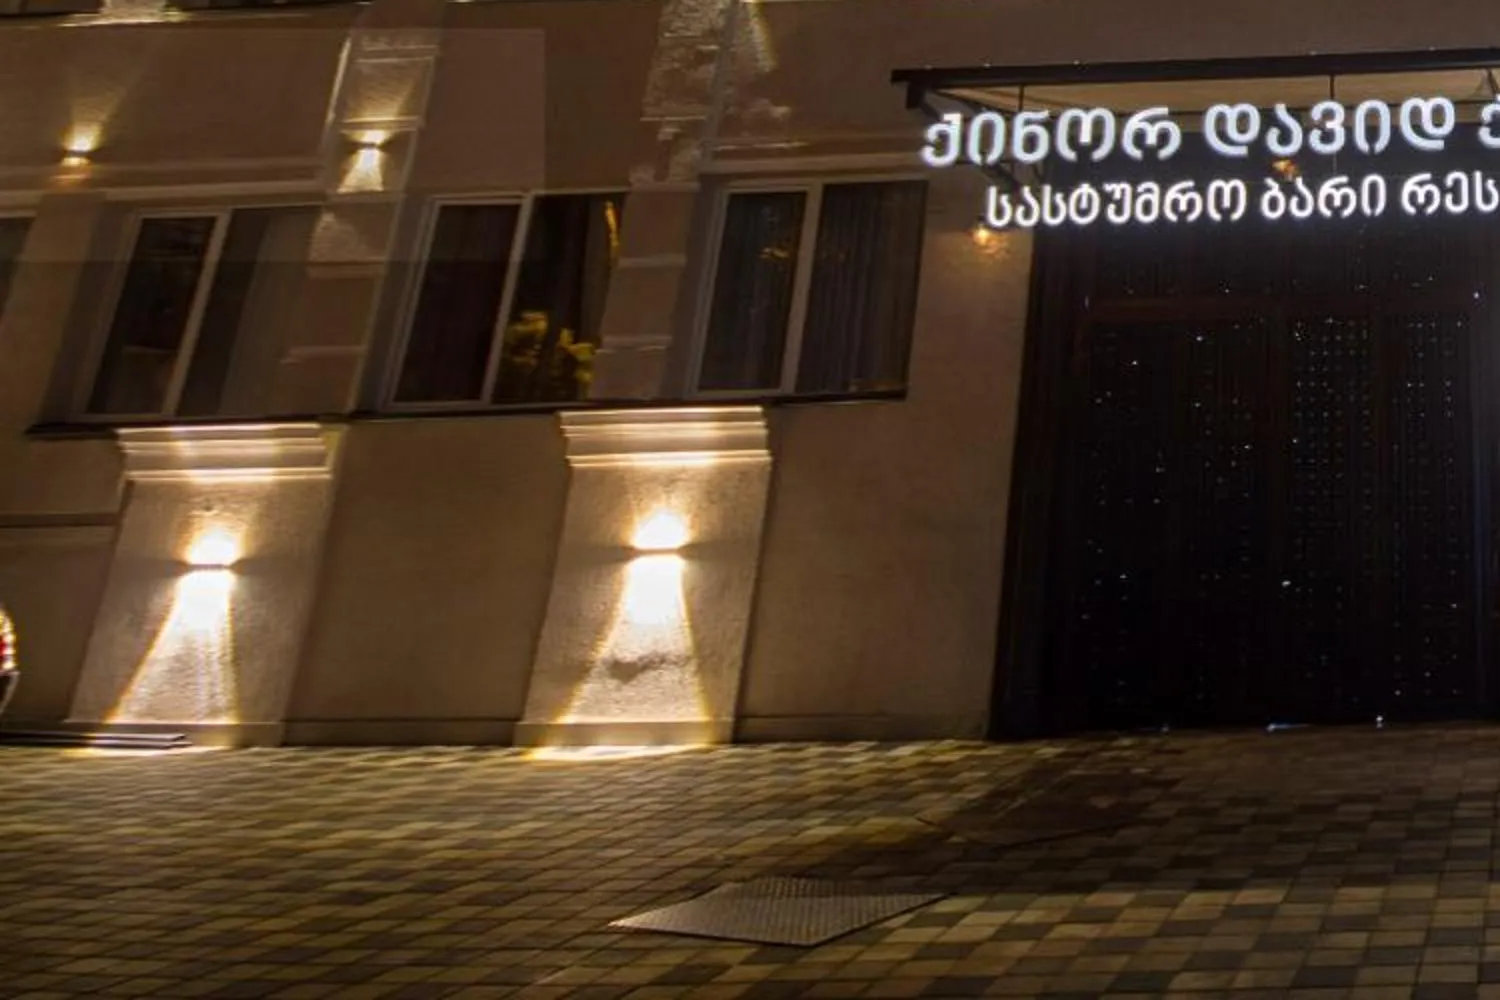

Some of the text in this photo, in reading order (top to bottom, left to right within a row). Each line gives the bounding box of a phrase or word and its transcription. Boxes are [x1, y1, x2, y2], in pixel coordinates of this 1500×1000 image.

[922, 107, 1181, 166] ქინორ
[1204, 97, 1455, 156] დავიდ
[987, 178, 1247, 227] სასტუმრო
[1260, 174, 1387, 220] ბარი
